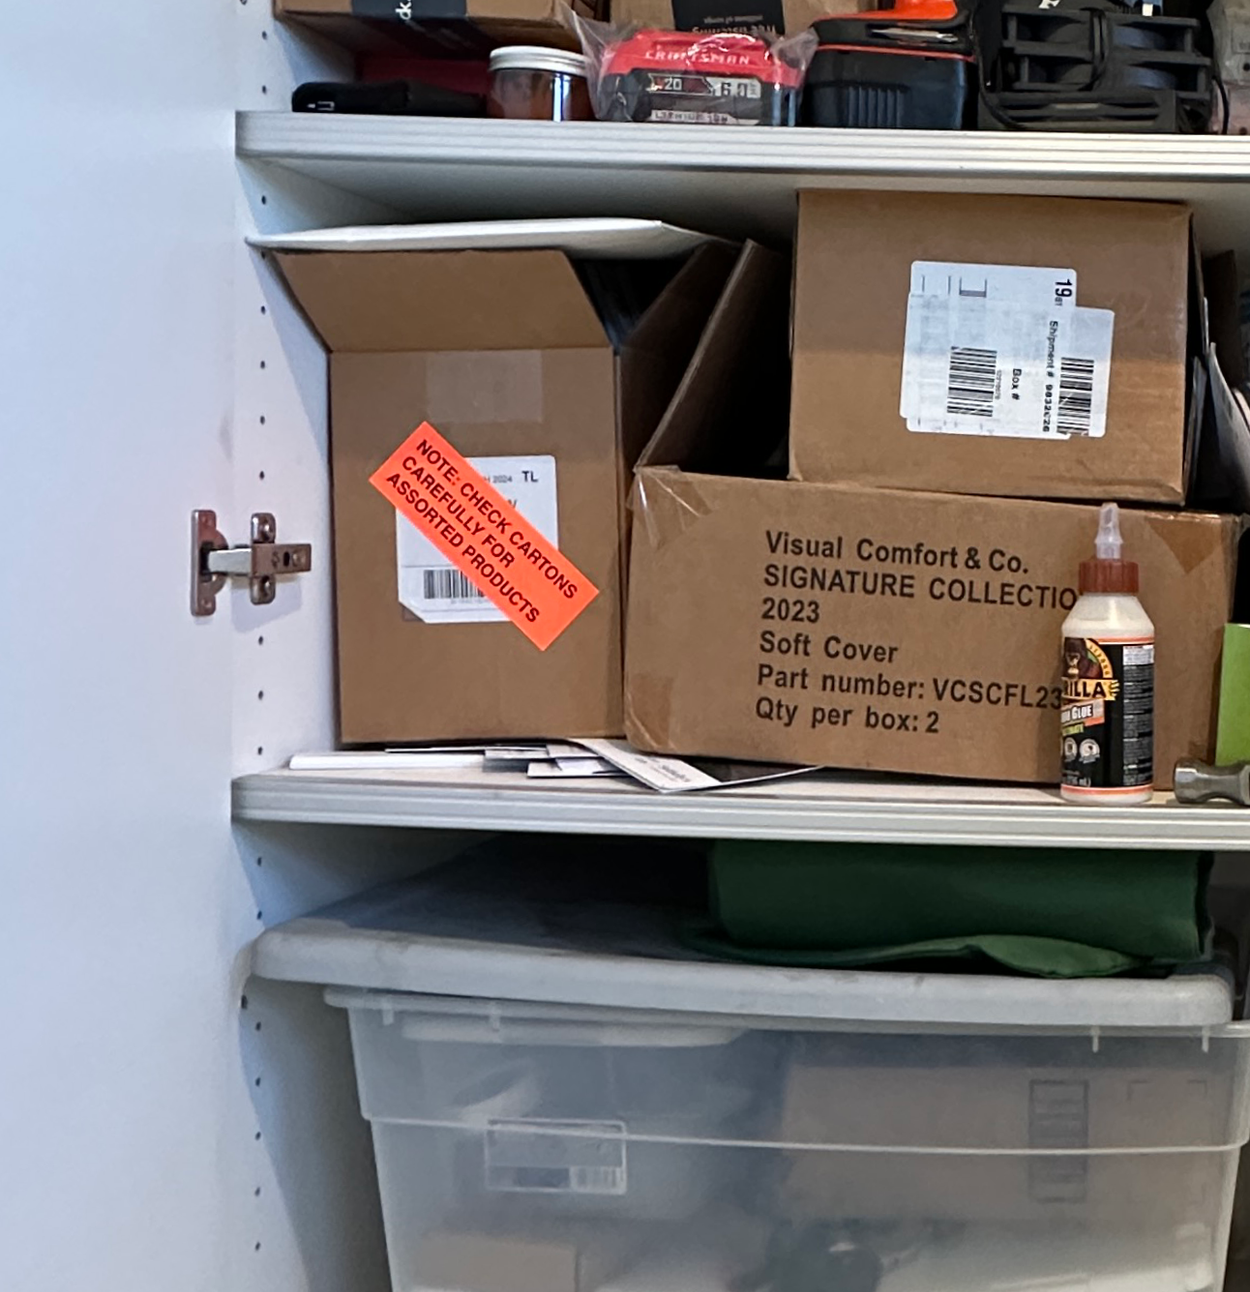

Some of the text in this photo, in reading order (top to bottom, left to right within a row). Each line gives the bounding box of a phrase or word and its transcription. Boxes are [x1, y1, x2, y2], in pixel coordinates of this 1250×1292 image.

[1054, 278, 1074, 298] 19
[1012, 368, 1023, 390] Box
[521, 470, 539, 483] TL
[401, 456, 516, 569] CAREFULLY FOR
[416, 439, 579, 600] NOTE: CHECK CARTONS
[386, 473, 541, 624] ASSORTED PRODUCTS
[766, 530, 1029, 574] Visual Comfort & Co.
[763, 564, 1078, 611] SIGNATURE COLLECTIO
[761, 597, 821, 624] 2023
[759, 630, 899, 664] Soft Cover
[757, 663, 809, 690] Part
[820, 673, 925, 700] number:
[755, 696, 940, 734] Qty per box: 2
